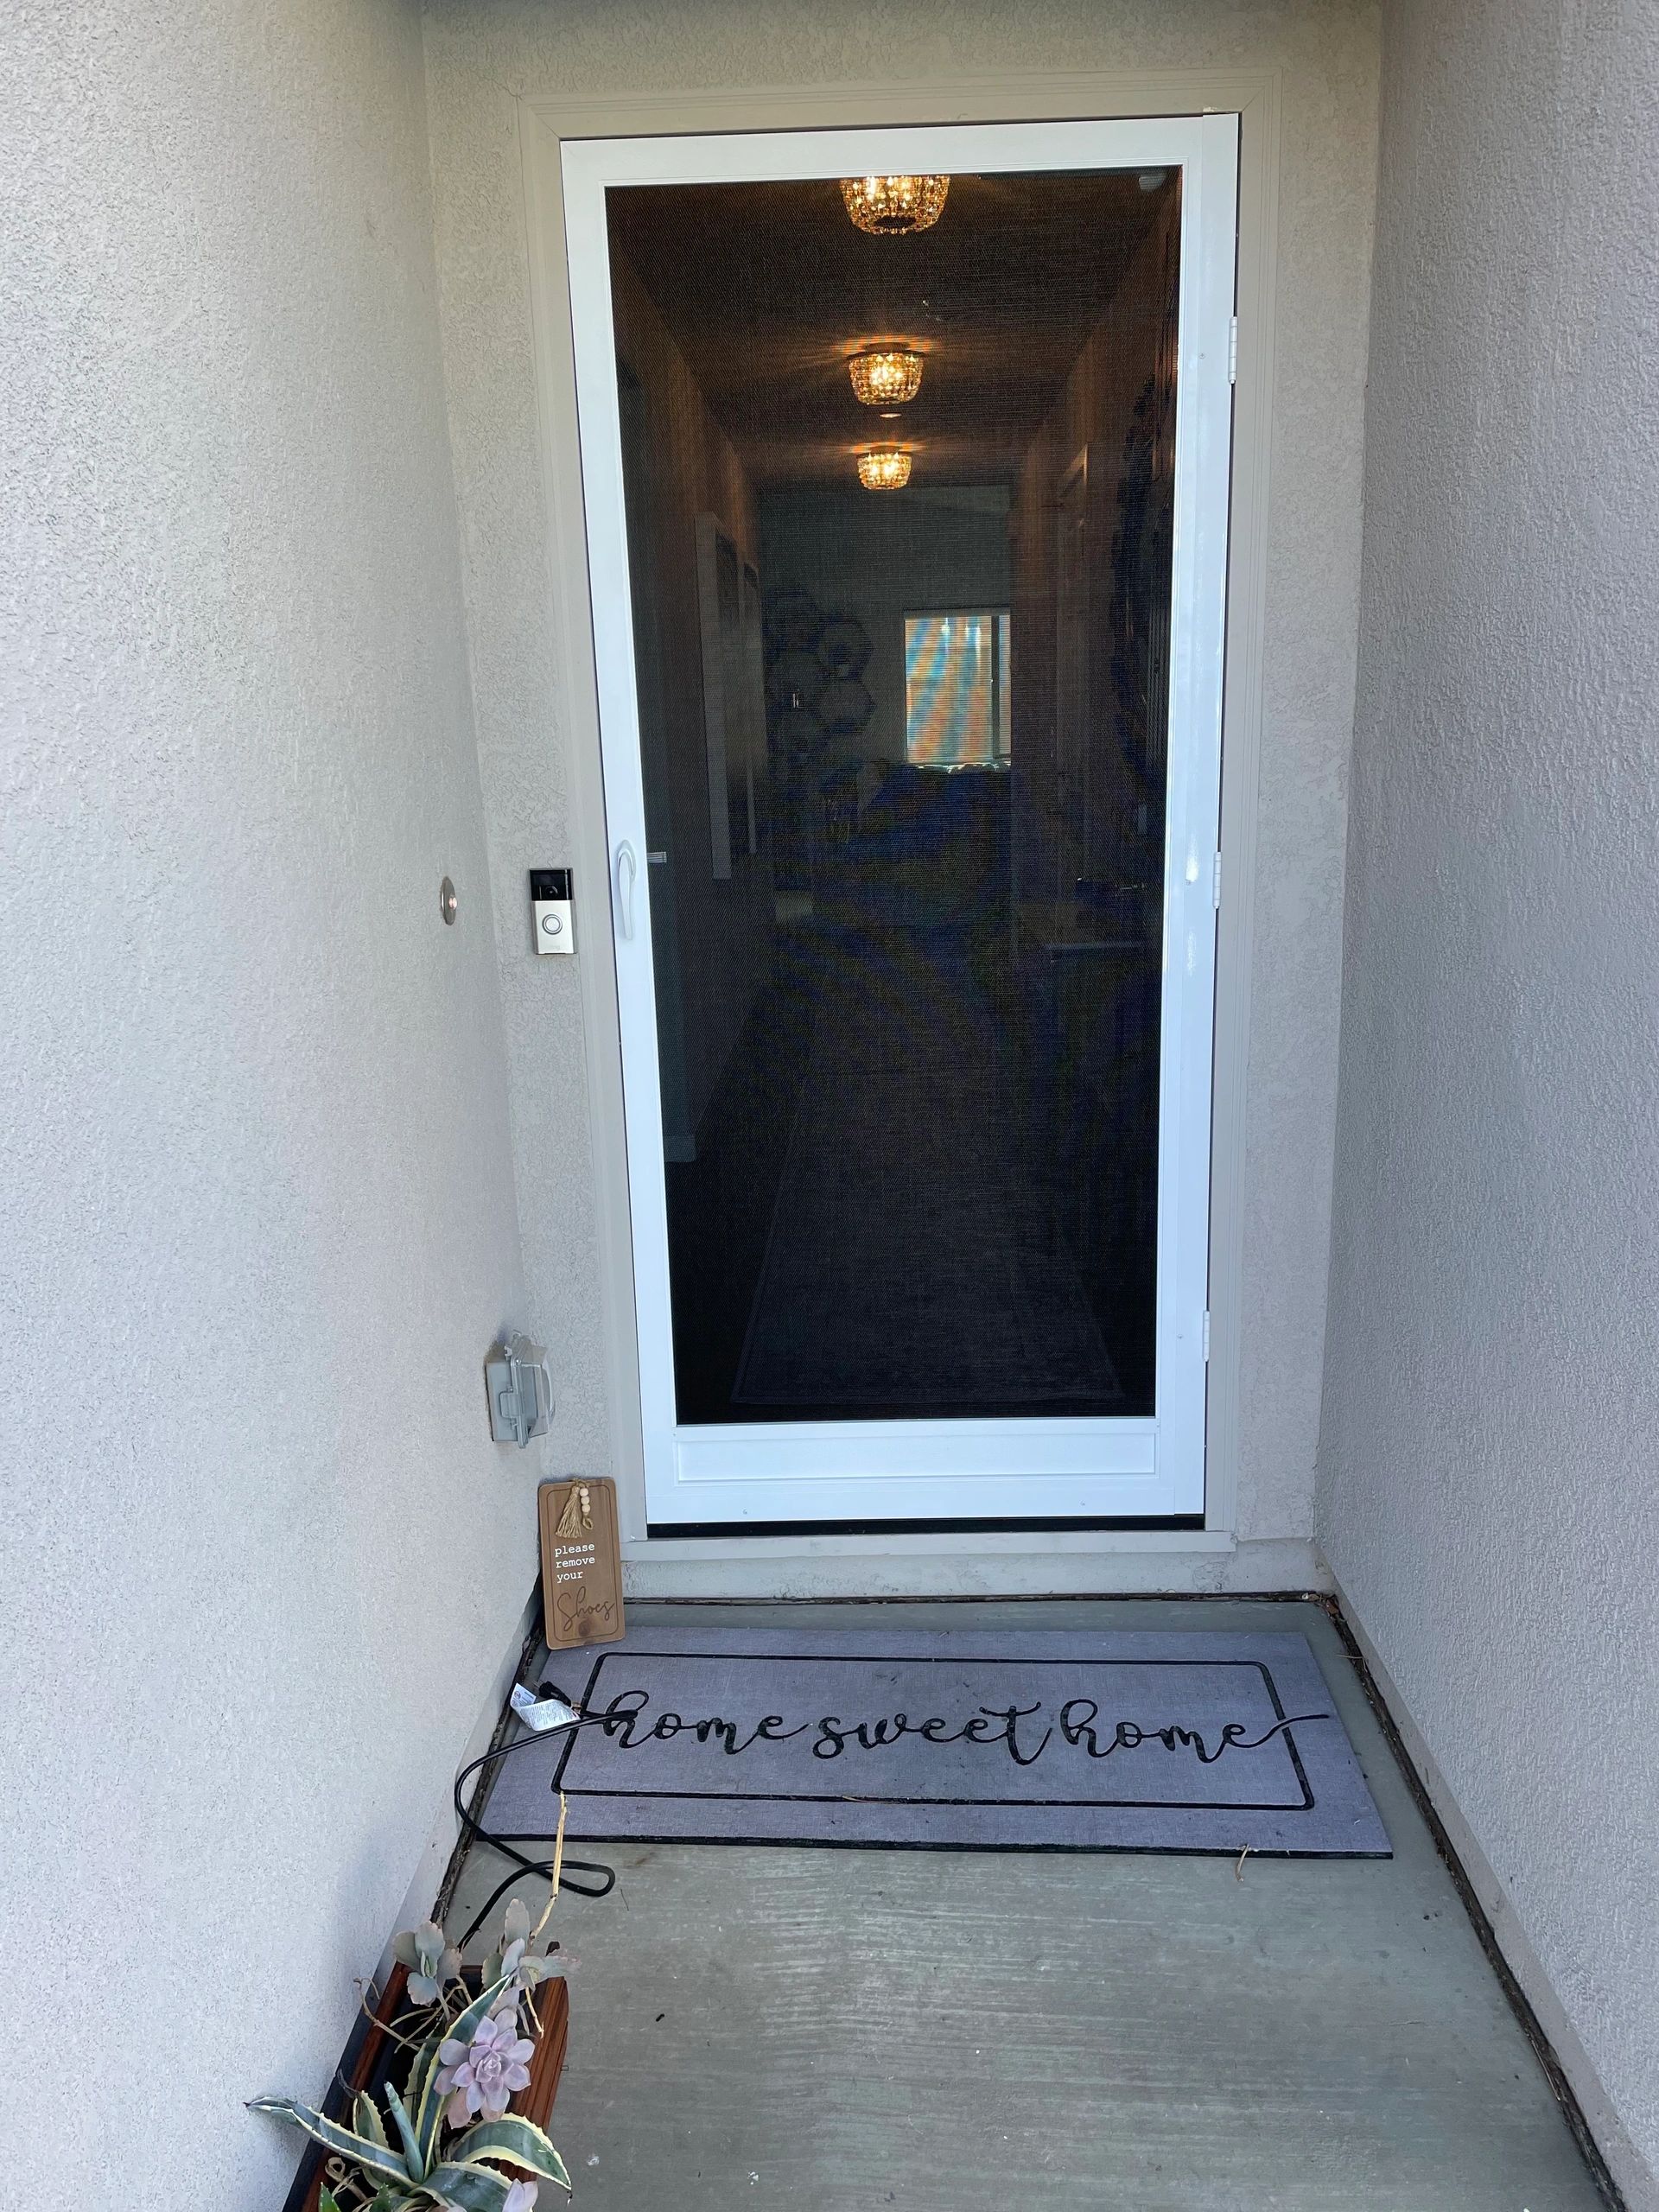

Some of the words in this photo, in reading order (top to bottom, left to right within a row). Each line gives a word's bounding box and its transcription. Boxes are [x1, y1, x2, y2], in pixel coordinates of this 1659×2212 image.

[554, 1541, 595, 1557] please
[556, 1556, 595, 1569] remove
[556, 1570, 584, 1584] your
[556, 1586, 615, 1632] Shoes
[604, 1690, 810, 1755] home
[812, 1701, 1052, 1765] sweet
[1059, 1699, 1330, 1764] home
